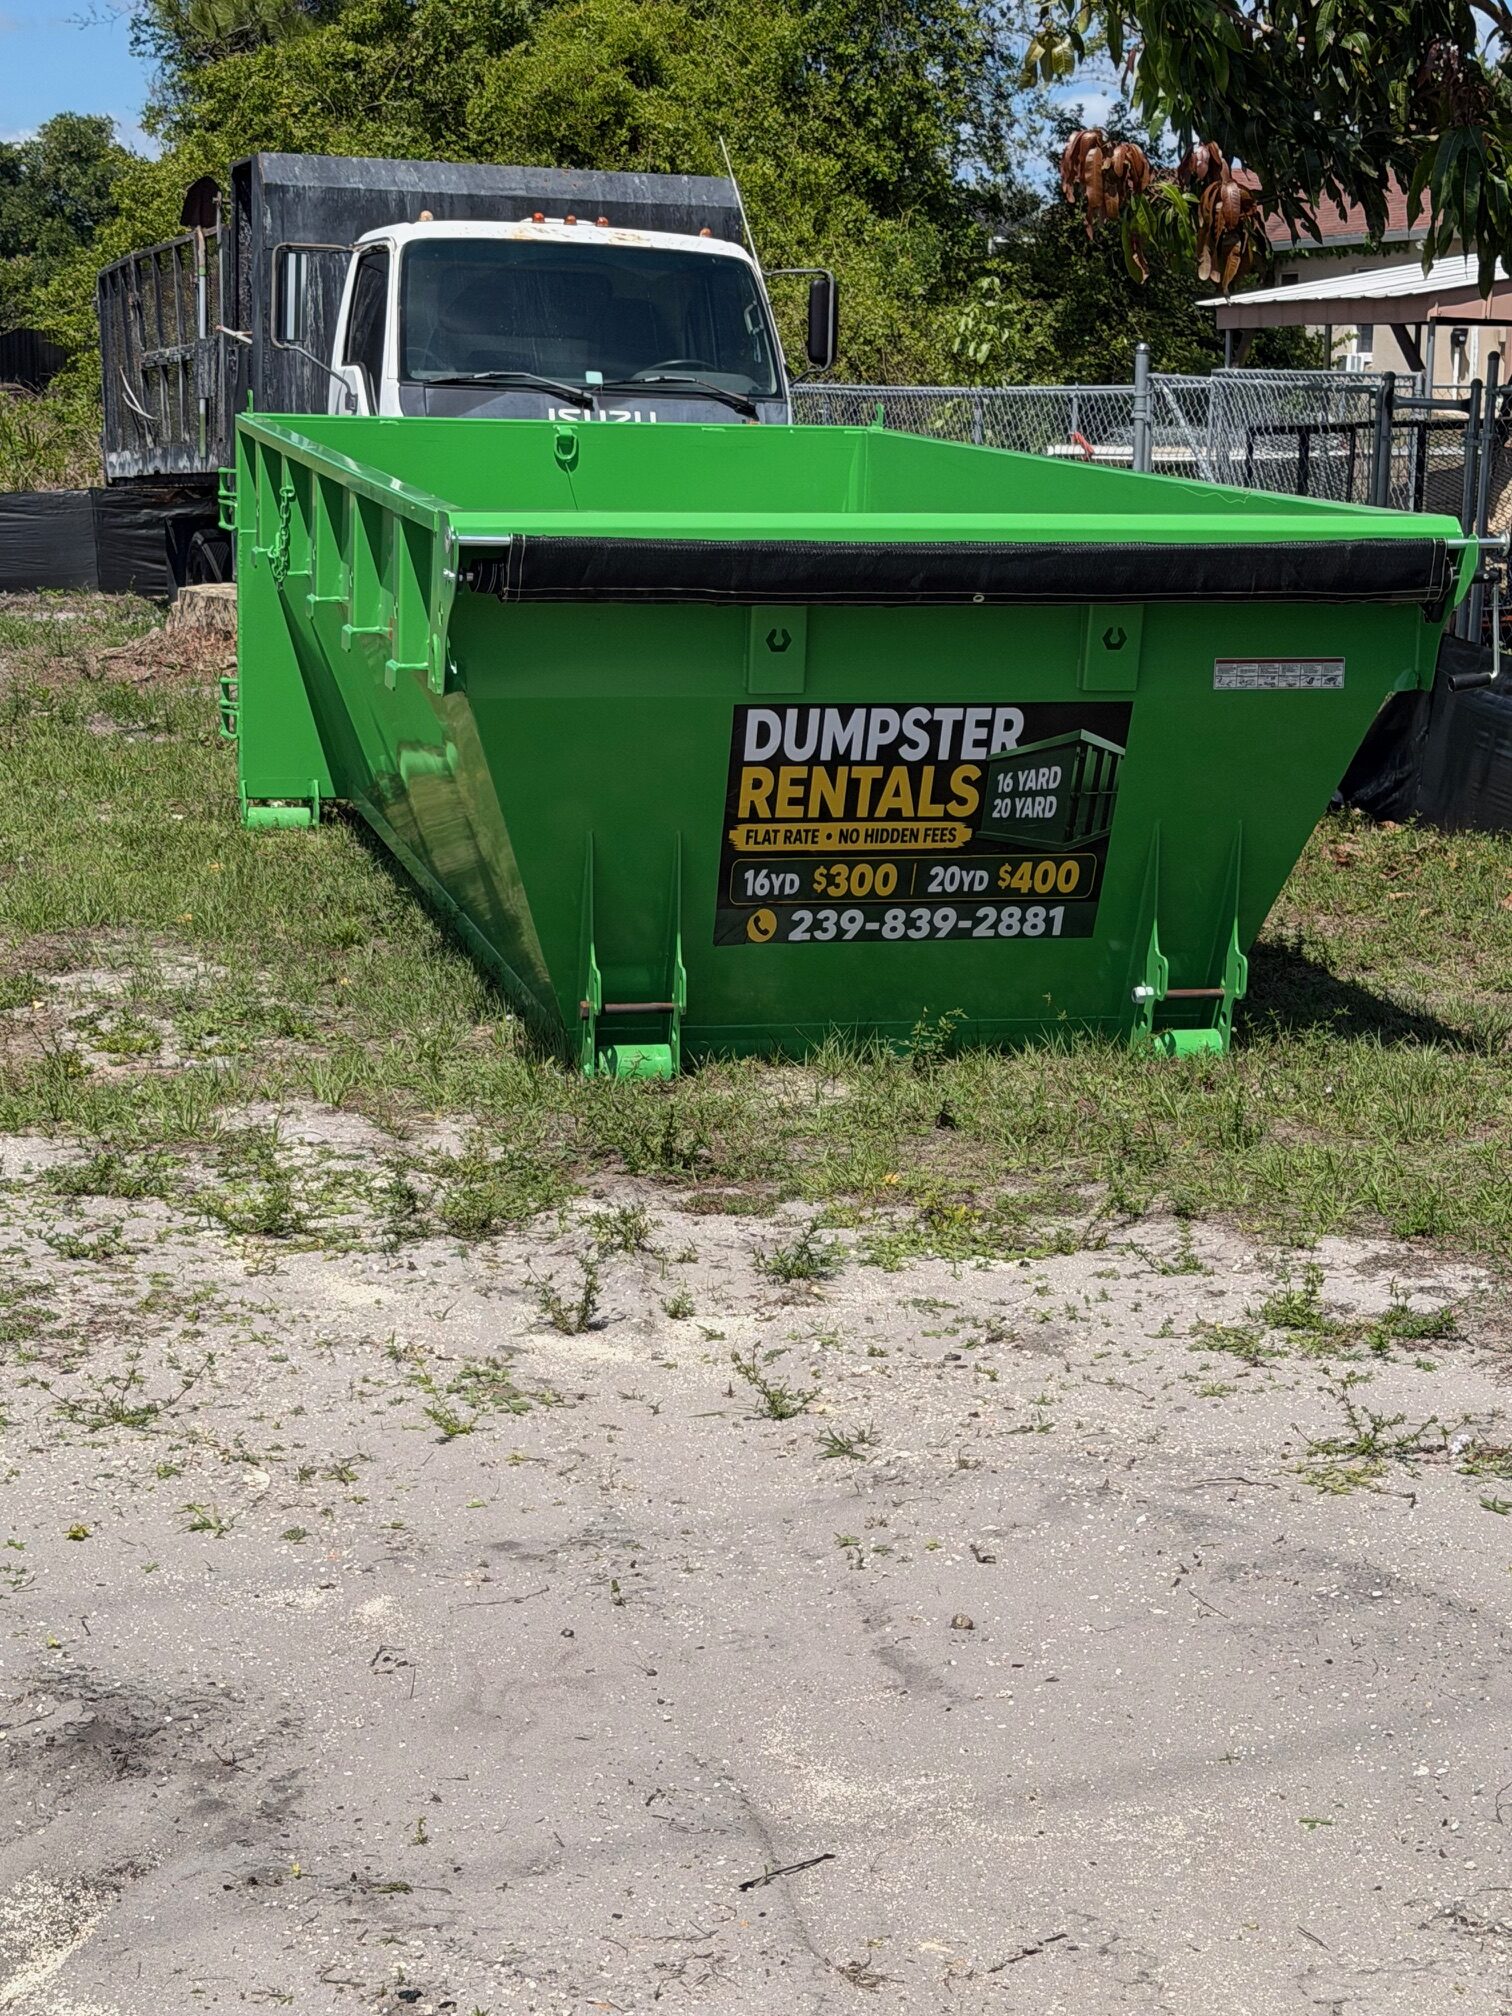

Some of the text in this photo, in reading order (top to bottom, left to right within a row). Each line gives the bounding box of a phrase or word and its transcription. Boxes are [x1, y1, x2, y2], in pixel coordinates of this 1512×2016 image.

[743, 707, 1024, 761] DUMPSTER
[737, 764, 981, 818] RENTALS
[997, 766, 1062, 793] 16 YARD
[992, 796, 1057, 818] 20 YARD
[745, 826, 957, 845] FLAT RATE NO HIDDEN FEES
[744, 860, 1080, 897] 16YD $300 20YD $400
[788, 906, 1064, 940] 239-839-2881
